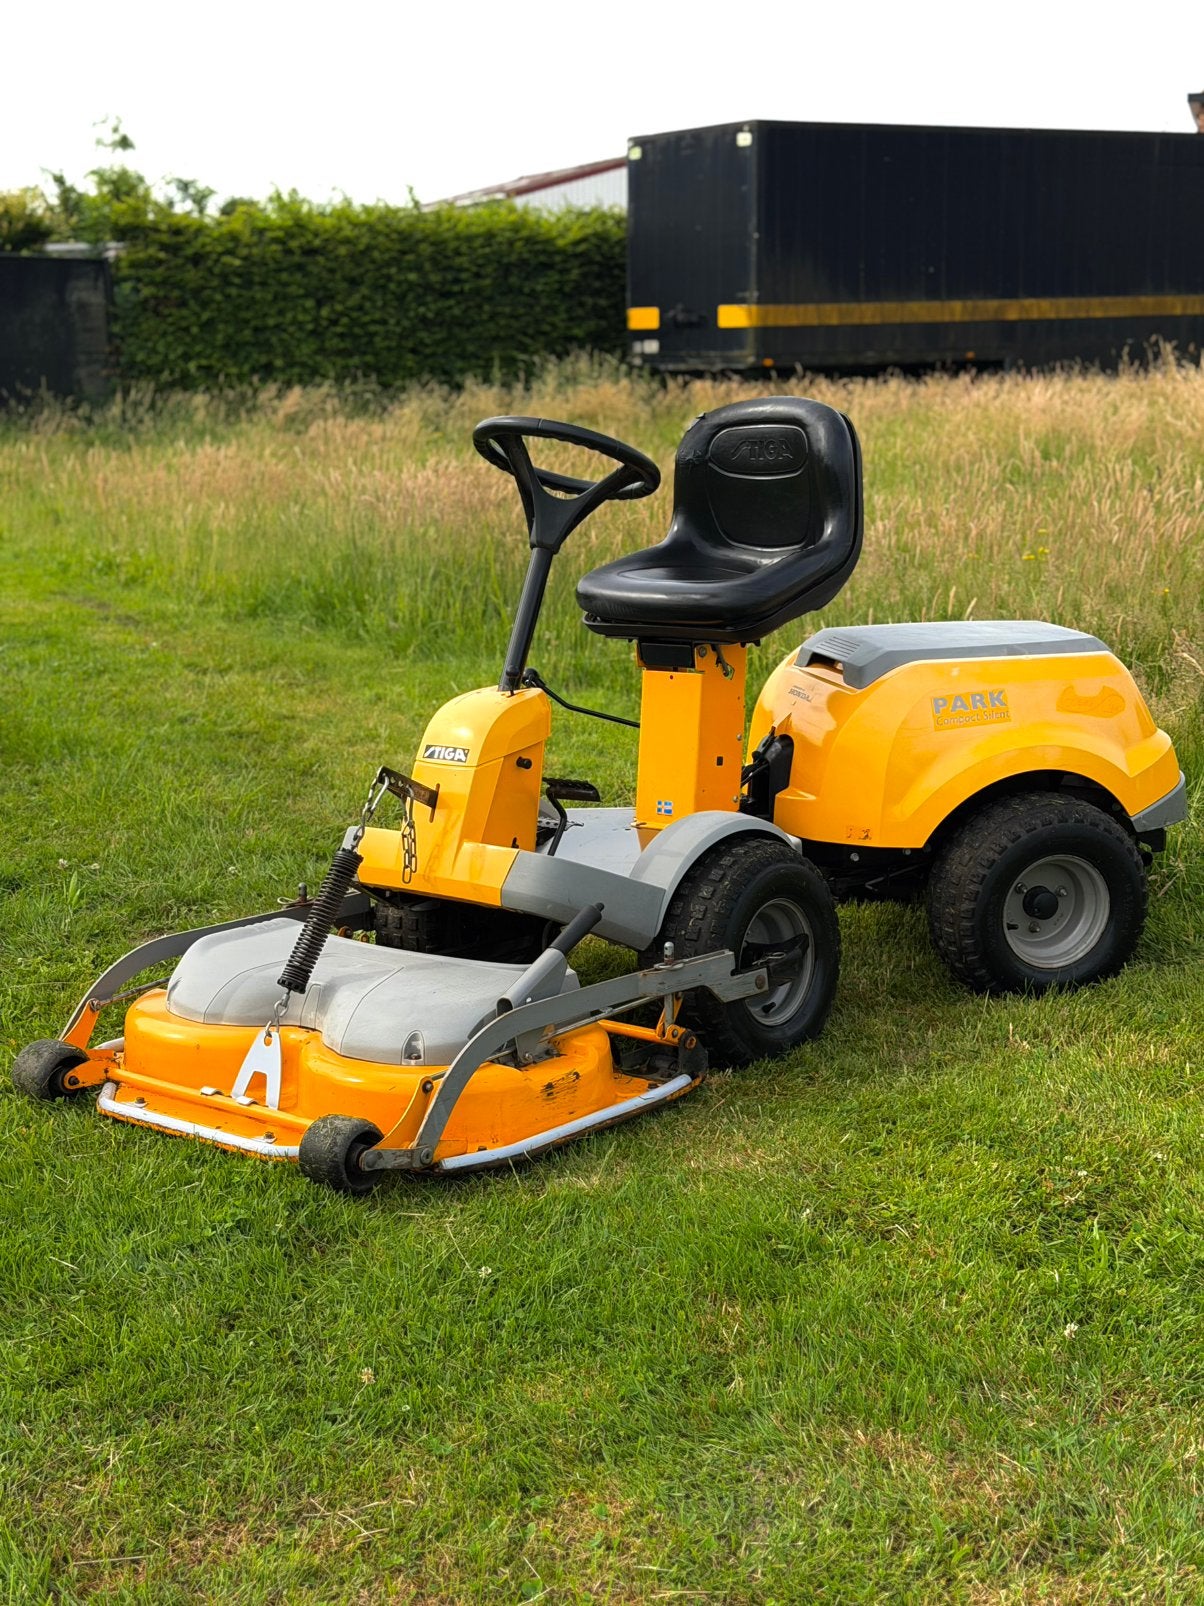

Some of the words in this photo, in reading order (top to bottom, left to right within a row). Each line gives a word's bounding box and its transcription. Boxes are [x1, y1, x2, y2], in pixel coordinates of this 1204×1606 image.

[730, 438, 793, 461] STIGA
[933, 690, 1007, 714] PARK
[936, 713, 980, 727] Compact
[983, 710, 1011, 721] Silent
[424, 746, 467, 762] STIGA
